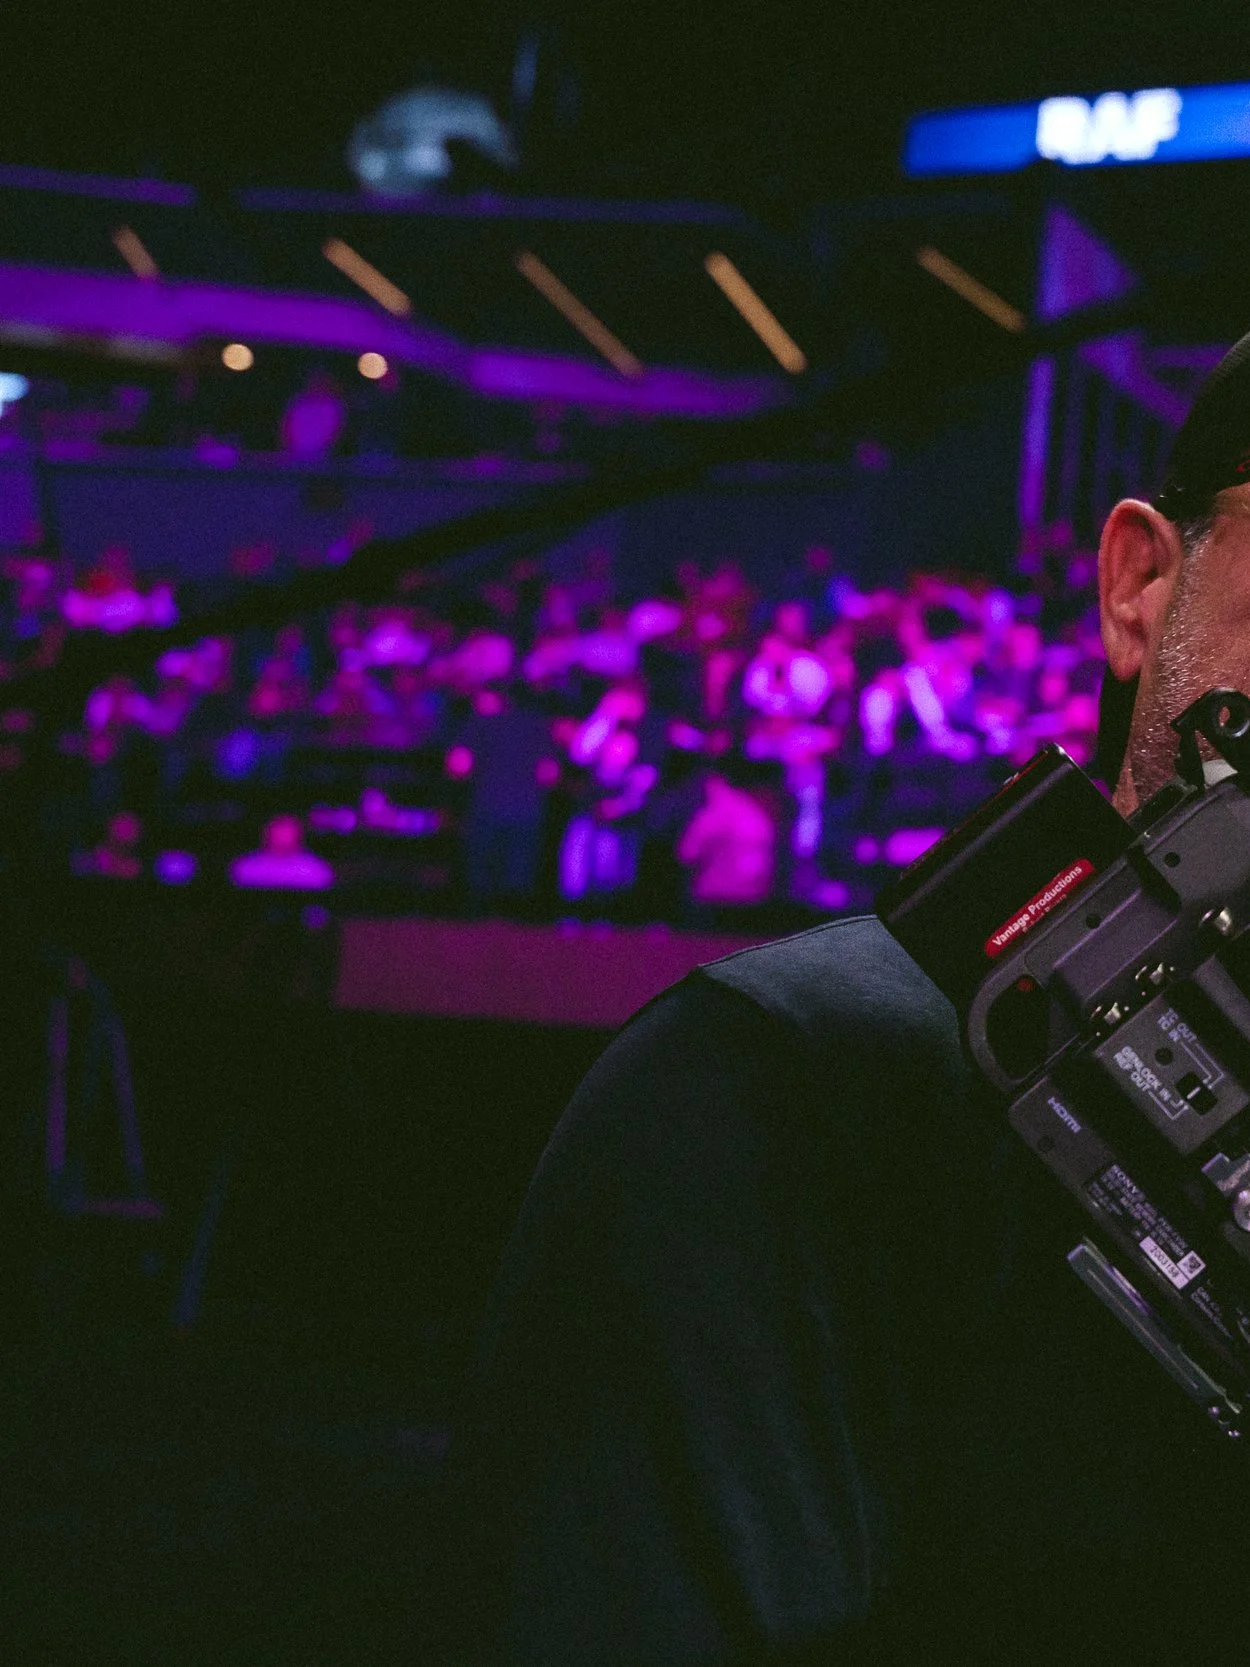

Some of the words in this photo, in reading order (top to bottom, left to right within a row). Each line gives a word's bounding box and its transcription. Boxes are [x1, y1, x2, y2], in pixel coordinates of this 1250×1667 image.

[992, 913, 1030, 946] Vantage
[1027, 866, 1082, 915] Productions
[1176, 1023, 1197, 1043] OUT
[1131, 1071, 1151, 1091] OUT
[1048, 1096, 1081, 1133] HDMI
